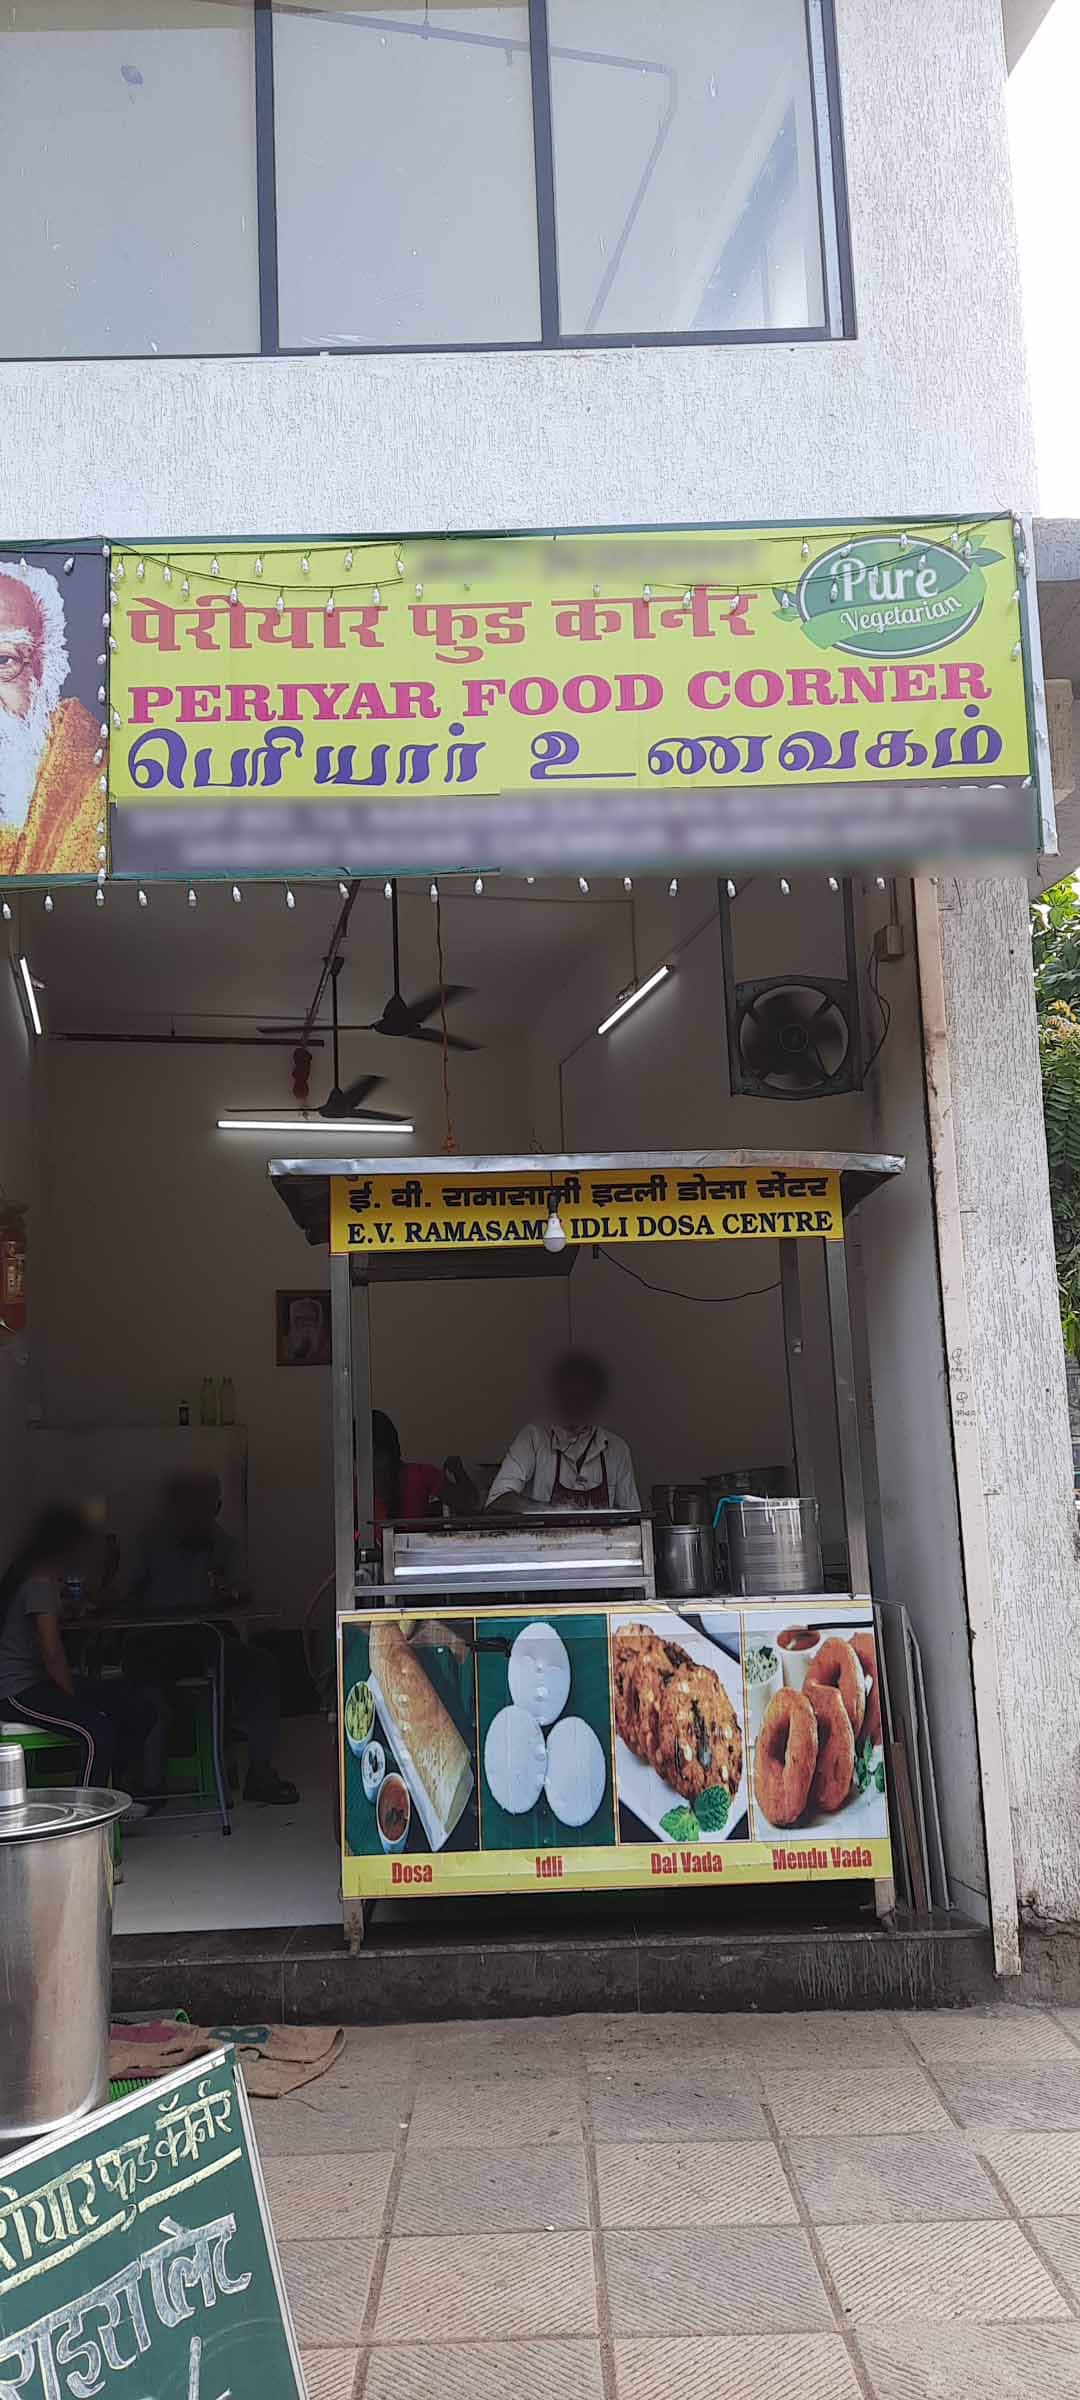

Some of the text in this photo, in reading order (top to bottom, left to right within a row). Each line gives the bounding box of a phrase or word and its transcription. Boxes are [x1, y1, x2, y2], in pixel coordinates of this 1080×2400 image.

[830, 557, 939, 602] Pure
[127, 595, 389, 651] पेरीयार
[408, 601, 532, 664] फुड
[840, 596, 962, 634] Vegetarian
[128, 662, 991, 724] PERIYAR FOOD CORNER
[128, 704, 1002, 789] பெரியார் உணவகம்
[591, 1174, 668, 1207] इटली
[677, 1173, 747, 1201] डोसा
[348, 1211, 833, 1245] E.V. RAMASAM IDLI DOSA CENTRE
[391, 1862, 433, 1885] Dosa
[535, 1855, 563, 1879] Idli
[650, 1850, 723, 1875] Dal Vada
[771, 1846, 873, 1871] Mendu Vada
